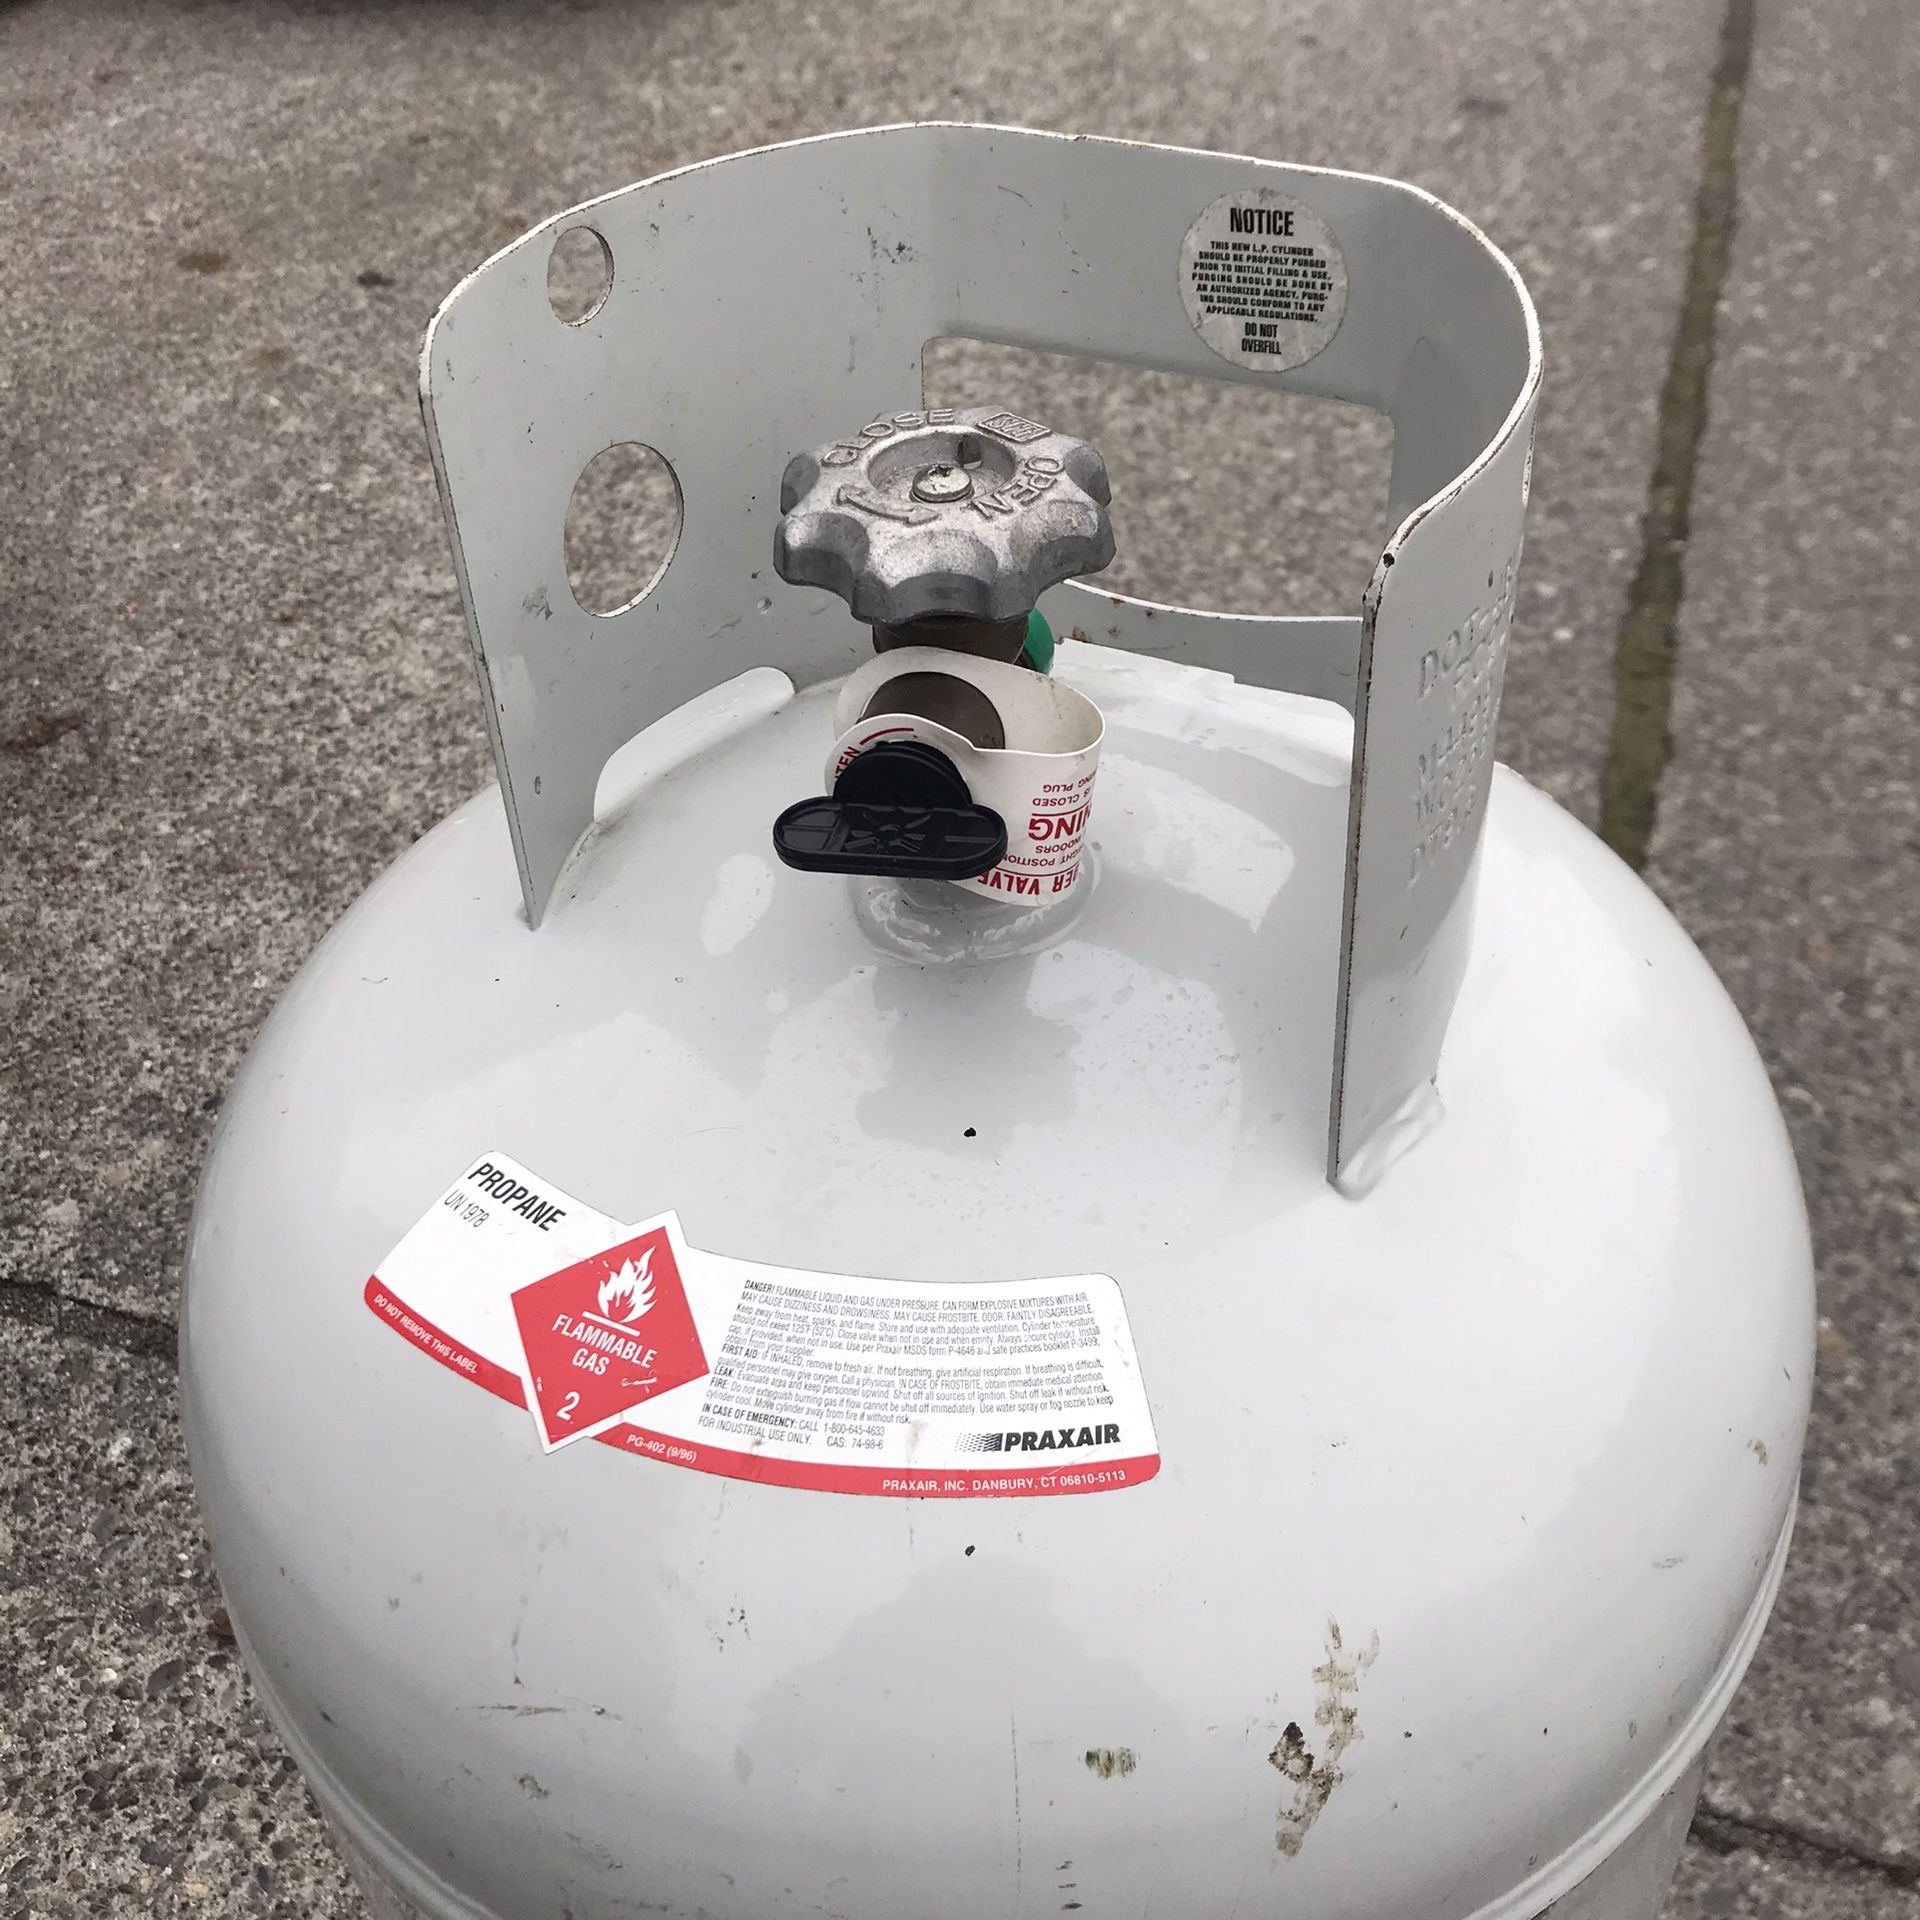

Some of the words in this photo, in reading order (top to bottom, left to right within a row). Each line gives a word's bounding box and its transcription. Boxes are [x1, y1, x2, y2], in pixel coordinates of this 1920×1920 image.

[1230, 208, 1294, 236] NOTICE
[1199, 251, 1230, 261] SHOULD
[1233, 254, 1243, 262] BE
[1247, 255, 1289, 265] PROPERLY
[1292, 258, 1326, 268] PURGED
[1211, 241, 1229, 250] THIS
[1232, 243, 1250, 252] NEW
[1253, 244, 1269, 253] L.P.
[1272, 245, 1313, 256] CYLINDER
[1192, 273, 1232, 282] PURGING
[1236, 276, 1272, 286] SHOULD
[1276, 279, 1287, 287] BE
[1292, 280, 1316, 289] DONE
[1320, 282, 1333, 291] BY
[1194, 262, 1218, 271] PRIOR
[1222, 263, 1232, 272] TO
[1235, 265, 1265, 274] INITIAL
[1267, 267, 1299, 277] FILLING
[1302, 270, 1308, 278] &
[1311, 271, 1331, 280] USE.
[1196, 284, 1208, 292] AN
[1210, 284, 1261, 296] AUTHORIZED
[1302, 292, 1328, 301] PURG-
[1200, 295, 1214, 303] ING
[1216, 296, 1248, 305] SHOULD
[1250, 298, 1291, 309] CONFORM
[1294, 302, 1305, 310] TO
[1308, 303, 1325, 312] ANY
[1206, 305, 1256, 317] APPLICABLE
[1259, 310, 1318, 322] REGULATIONS.
[1245, 322, 1257, 336] DO
[1260, 323, 1278, 338] NOT
[1242, 338, 1282, 354] OVERFILL
[822, 408, 954, 466] CLOSE
[972, 456, 1065, 520] OPEN
[1032, 794, 1079, 806] CLOSED
[1043, 783, 1073, 793] PLUG
[977, 868, 1039, 895] VALVE
[444, 1189, 469, 1211] UN
[460, 1202, 489, 1228] 1978
[467, 1162, 567, 1231] PROPANE
[741, 1291, 758, 1302] MAY
[759, 1295, 783, 1307] CAUSE
[784, 1299, 822, 1312] DIZZINESS
[822, 1306, 839, 1315] AND
[840, 1307, 891, 1320] DROWSINESS.
[894, 1311, 911, 1320] MAY
[912, 1312, 936, 1322] CAUSE
[939, 1312, 980, 1322] FROSTBITE.
[1007, 1310, 1036, 1320] FAINTLY
[1038, 1304, 1094, 1318] DISAGREEABLE.
[744, 1280, 775, 1292] DANGER!
[776, 1286, 818, 1300] FLAMMABLE
[819, 1292, 842, 1303] LIQUID
[843, 1295, 858, 1305] AND
[860, 1296, 875, 1306] GAS
[876, 1298, 900, 1308] UNDER
[902, 1300, 940, 1310] PRESSURE.
[943, 1301, 956, 1310] CAN
[959, 1301, 979, 1310] FORM
[980, 1300, 1017, 1310] EXPLOSIVE
[1019, 1298, 1054, 1308] MIXTURES
[1056, 1294, 1074, 1305] WITH
[1075, 1292, 1088, 1303] AIR.
[374, 1294, 388, 1307] DO
[384, 1303, 403, 1319] NOT
[400, 1315, 433, 1343] REMOVE
[431, 1339, 452, 1356] THIS
[449, 1351, 478, 1373] LABEL
[552, 1314, 657, 1368] FLAMMABLE
[572, 1348, 610, 1375] GAS
[722, 1343, 743, 1357] FIRST
[744, 1348, 760, 1359] AID:
[761, 1352, 768, 1360] IF
[769, 1353, 804, 1367] INHALED,
[806, 1359, 832, 1369] remove
[834, 1362, 842, 1371] to
[843, 1362, 861, 1373] fresh
[877, 1365, 883, 1374] If
[884, 1366, 896, 1375] not
[936, 1368, 950, 1378] give
[953, 1368, 981, 1377] artificial
[1025, 1365, 1031, 1374] If
[1033, 1363, 1066, 1374] breathing
[1068, 1362, 1074, 1371] is
[713, 1365, 735, 1377] LEAK:
[737, 1370, 770, 1384] Evacuate
[771, 1377, 787, 1387] area
[788, 1379, 802, 1389] and
[804, 1381, 822, 1393] keep
[822, 1385, 859, 1396] personnel
[893, 1390, 911, 1400] Shut
[913, 1390, 923, 1400] off
[925, 1391, 934, 1400] all
[936, 1392, 965, 1400] sources
[968, 1391, 976, 1399] of
[1010, 1390, 1027, 1399] Shut
[1029, 1388, 1039, 1398] off
[1041, 1388, 1056, 1397] leak
[1058, 1387, 1063, 1396] if
[1065, 1385, 1092, 1396] without
[556, 1391, 580, 1421] 2
[702, 1403, 711, 1412] IN
[712, 1405, 732, 1417] CASE
[734, 1409, 745, 1419] OF
[747, 1411, 798, 1428] EMERGENCY:
[799, 1421, 819, 1431] CALL
[824, 1423, 885, 1436] 1-800-645-4633
[705, 1389, 735, 1400] cylinder
[754, 1398, 774, 1409] Move
[776, 1403, 804, 1414] cylinder
[806, 1407, 825, 1419] away
[826, 1409, 843, 1419] from
[846, 1412, 858, 1420] fire
[860, 1412, 865, 1420] if
[867, 1413, 894, 1422] without
[698, 1416, 716, 1427] FOR
[716, 1420, 766, 1437] INDUSTRIAL
[768, 1430, 786, 1441] USE
[787, 1431, 812, 1444] ONLY.
[827, 1436, 846, 1447] CAS:
[852, 1438, 884, 1450] 74-98-6
[1005, 1424, 1121, 1451] PRAXAIR
[627, 1434, 665, 1454] PG-402
[666, 1446, 697, 1463] (9/96)
[883, 1480, 941, 1492] PRAXAIR,
[944, 1481, 969, 1492] INC.
[972, 1476, 1038, 1491] DANBURY,
[1041, 1475, 1056, 1487] CT
[1060, 1470, 1126, 1486] 06810-5113
